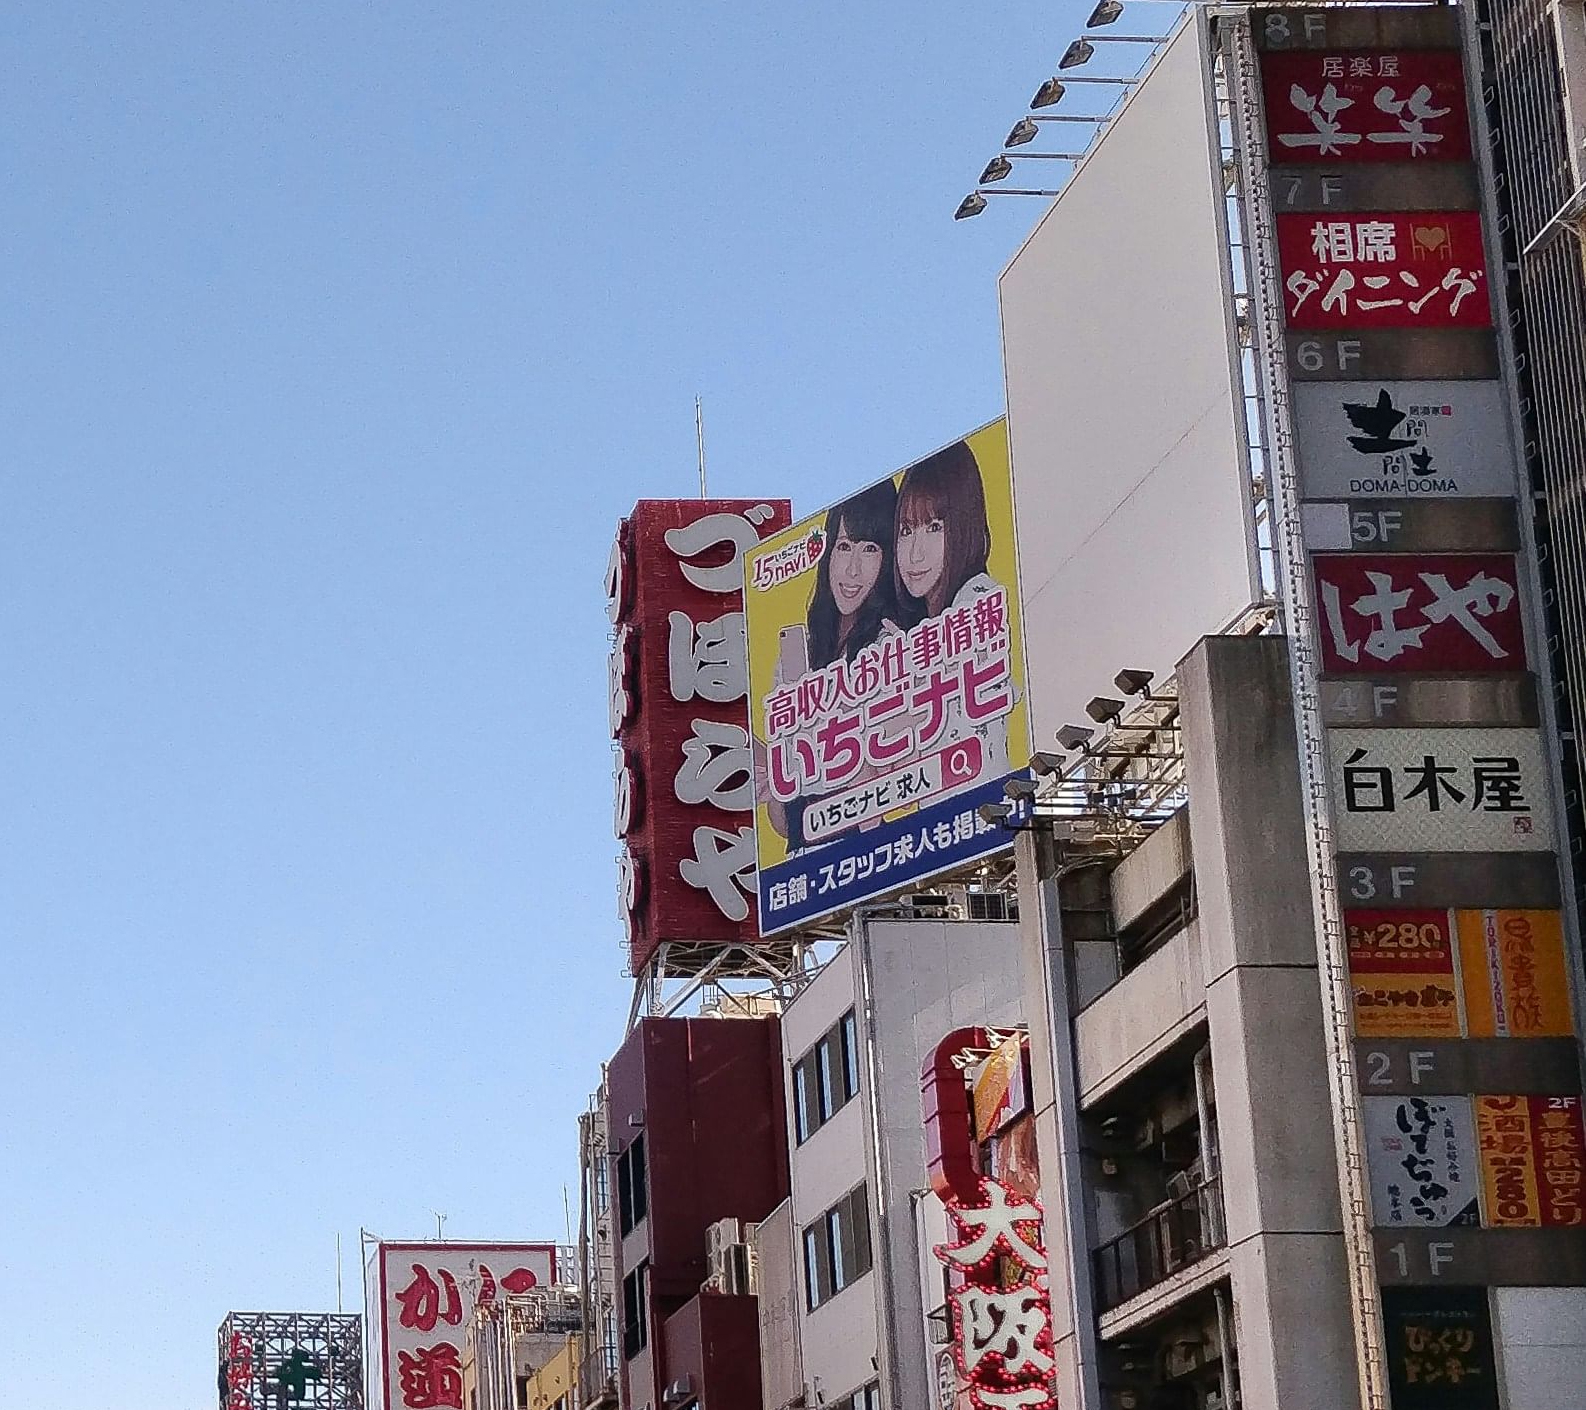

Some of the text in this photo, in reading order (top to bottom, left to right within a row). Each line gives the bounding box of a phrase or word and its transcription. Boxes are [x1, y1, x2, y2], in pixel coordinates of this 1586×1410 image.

[1321, 56, 1402, 78] 居楽屋
[1276, 83, 1451, 157] 笑笑
[1311, 221, 1396, 264] 相席
[1286, 267, 1484, 318] ダイニング
[1349, 478, 1459, 493] DOMA-DOMA
[1352, 511, 1402, 542] 5F
[767, 590, 1006, 738] 高収入お仕事情報
[770, 638, 1010, 796] いちごナビ
[808, 770, 932, 833] いちごナビ 求人
[1342, 748, 1531, 814] 白木屋
